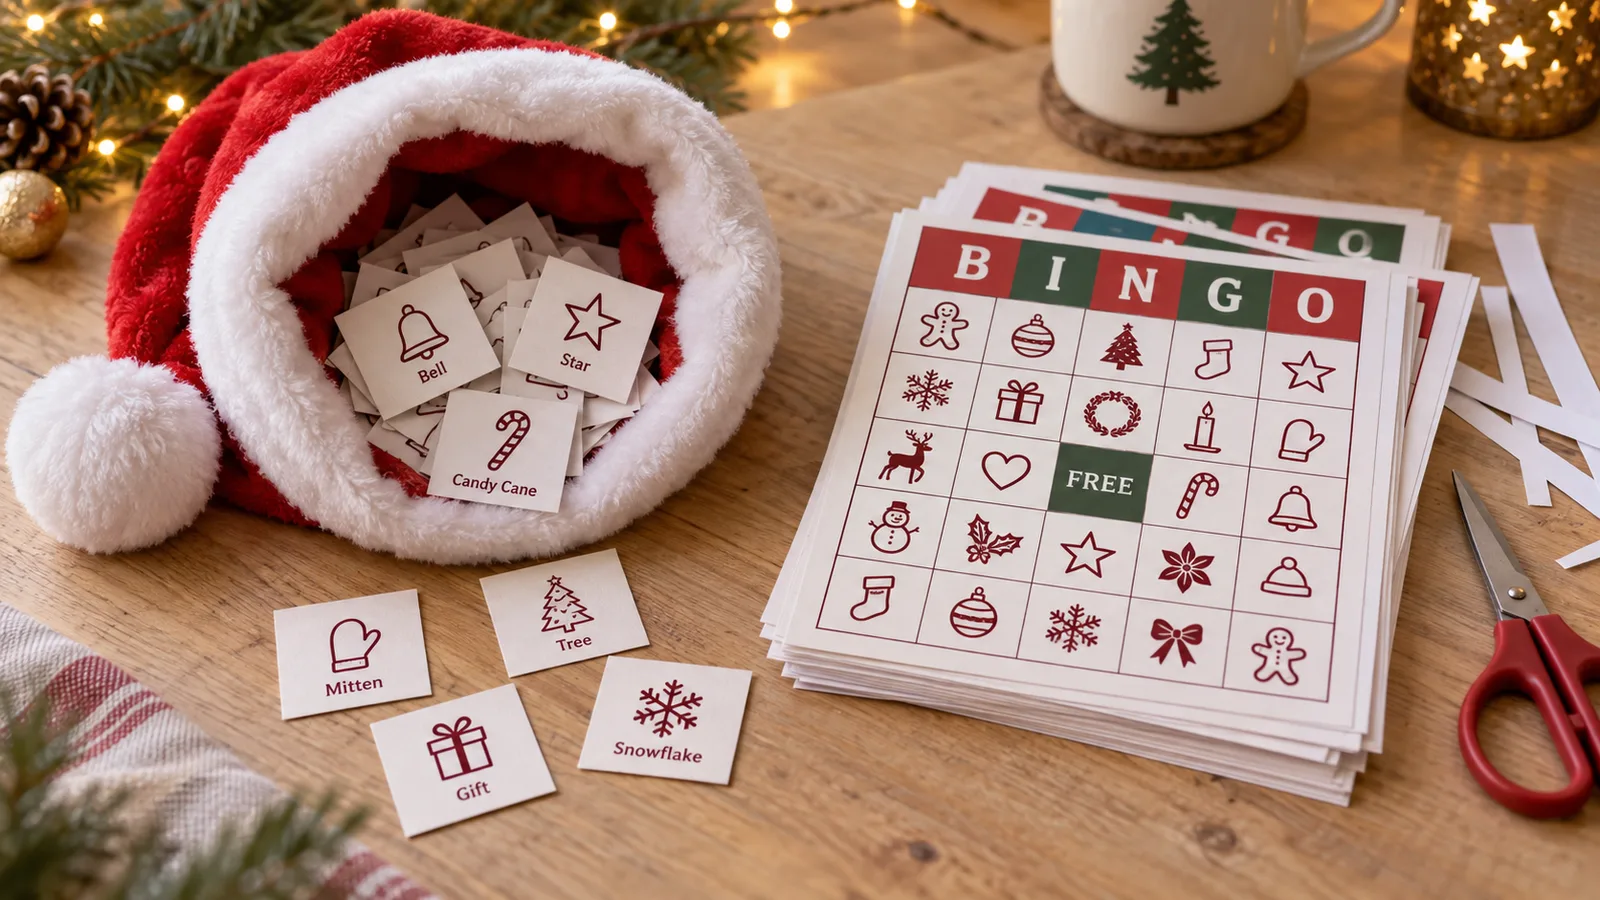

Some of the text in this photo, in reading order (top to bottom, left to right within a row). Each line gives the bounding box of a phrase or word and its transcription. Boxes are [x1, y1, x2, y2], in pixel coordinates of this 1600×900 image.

[417, 360, 448, 384] Bell
[560, 352, 592, 372] Star
[452, 473, 538, 498] Candy Cane
[1066, 469, 1134, 496] FREE
[555, 636, 592, 652] Tree
[325, 678, 383, 697] Mitten
[613, 741, 703, 763] Snowflake
[456, 781, 490, 801] Gift
